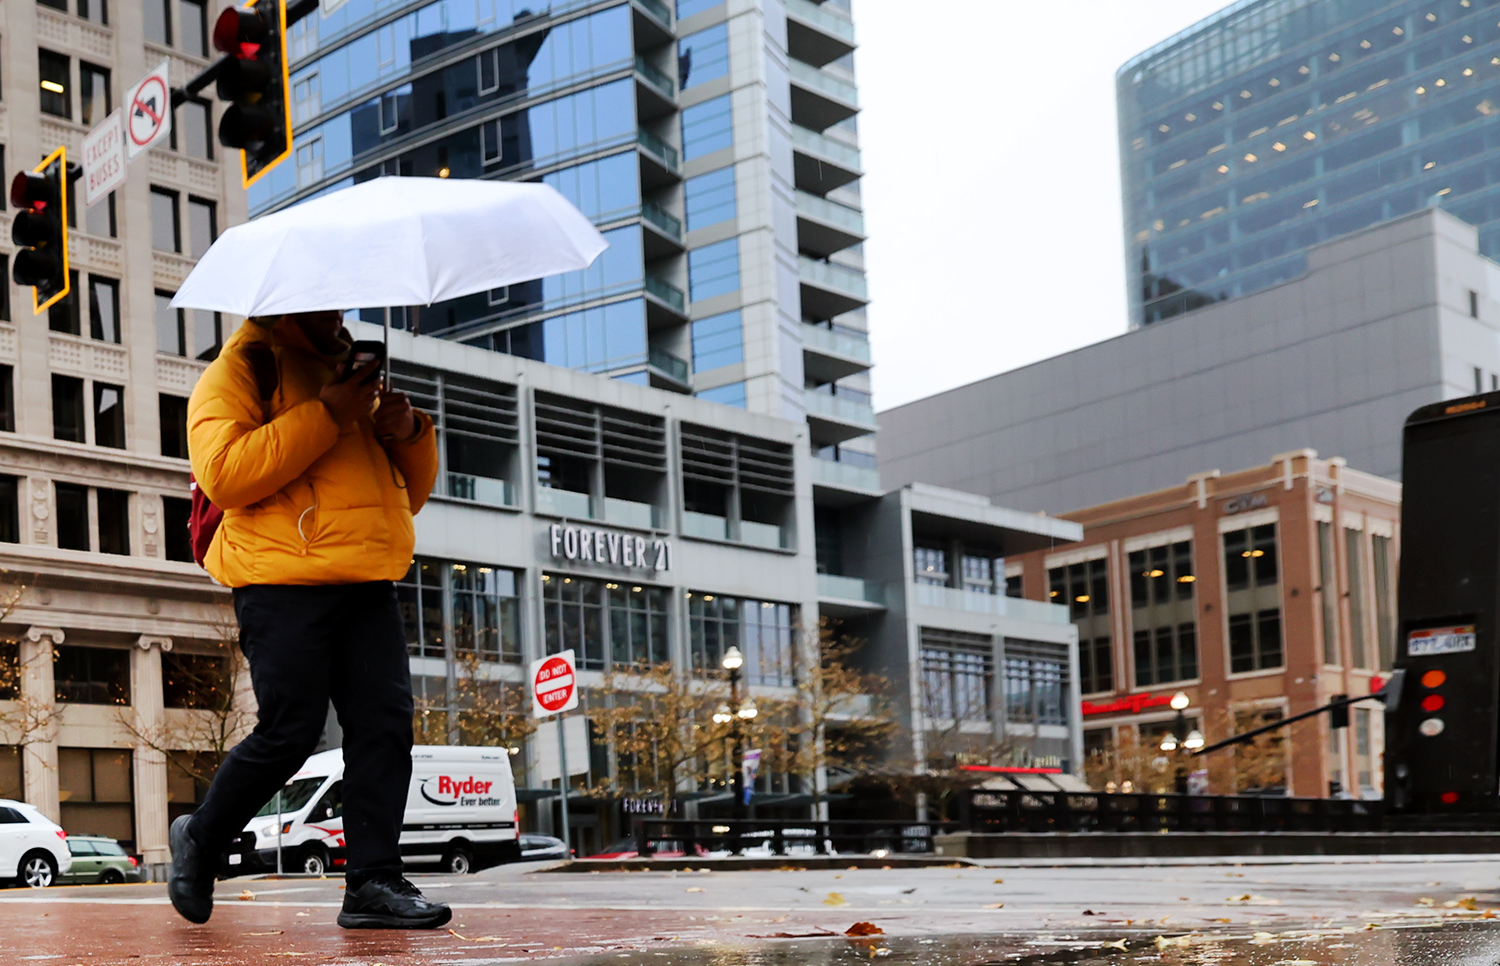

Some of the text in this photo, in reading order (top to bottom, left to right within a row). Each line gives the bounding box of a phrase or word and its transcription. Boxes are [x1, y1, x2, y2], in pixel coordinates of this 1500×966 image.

[86, 125, 119, 166] EXCEPT
[90, 153, 120, 191] BUSES
[550, 523, 673, 571] FOREVER 21
[539, 663, 567, 681] DO NOT
[543, 689, 567, 705] ENTER
[438, 776, 493, 799] Ryder
[461, 797, 501, 806] Ever better
